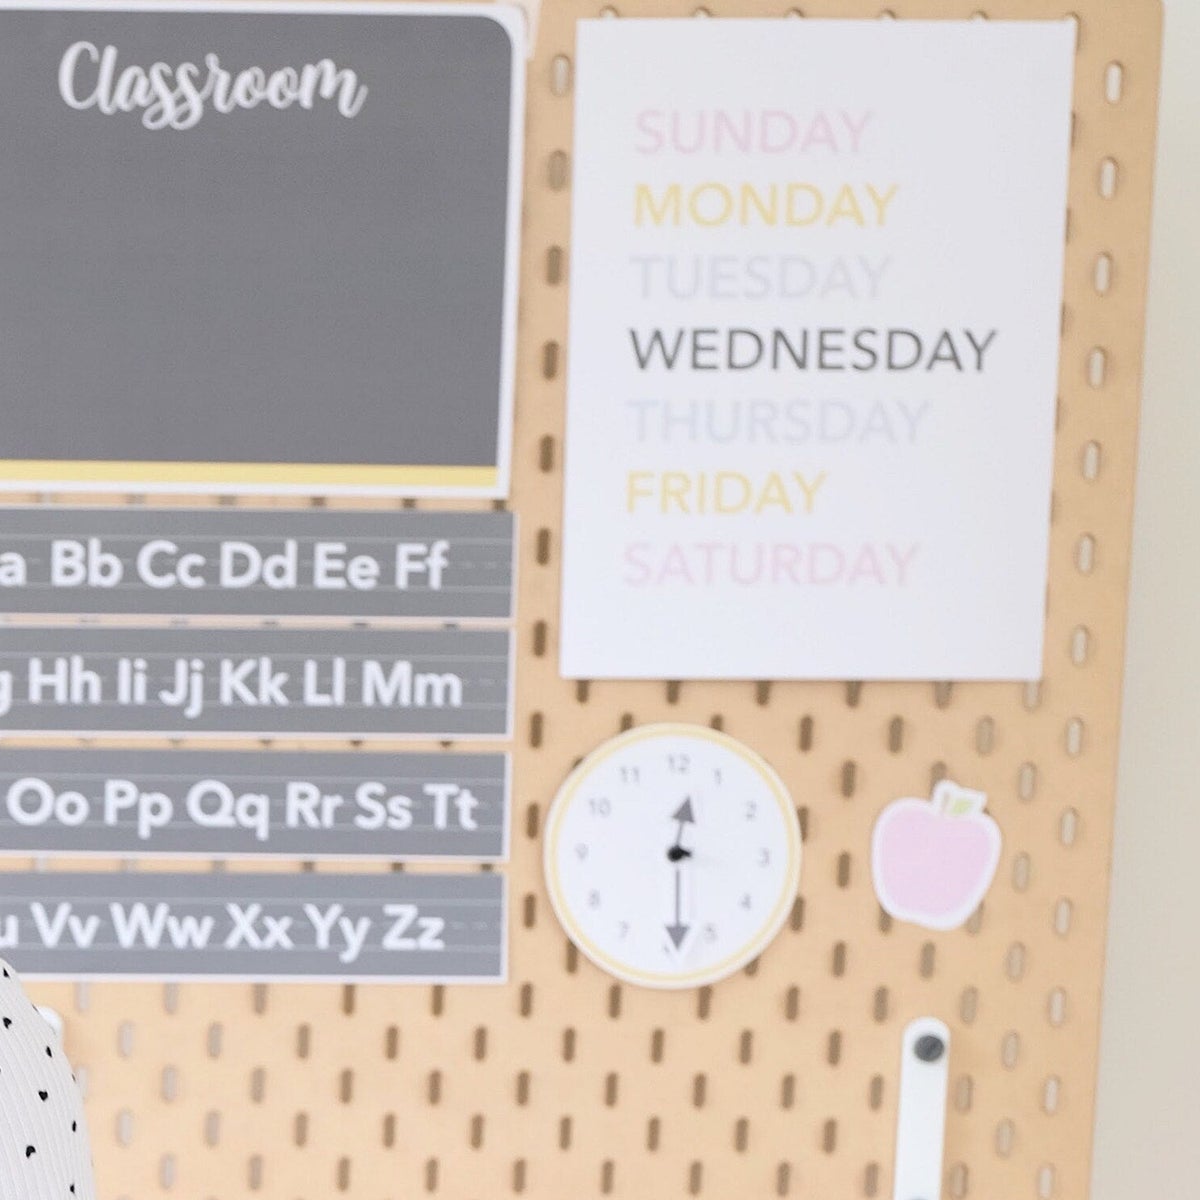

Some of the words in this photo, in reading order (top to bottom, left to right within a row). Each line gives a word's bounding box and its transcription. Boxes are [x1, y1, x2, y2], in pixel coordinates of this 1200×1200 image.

[57, 40, 369, 131] Classroom
[634, 108, 876, 157] SUNDAY
[632, 181, 899, 228] MONDAY
[628, 253, 895, 301] TUESDAY
[628, 327, 997, 373] WEDNESDAY
[623, 398, 932, 445] THURSDAY
[625, 469, 829, 516] FRIDAY
[50, 536, 124, 588] Bb
[136, 538, 206, 590] Cc
[219, 538, 298, 590] Dd
[313, 541, 381, 591] Ee
[395, 539, 450, 591] Ff
[622, 541, 922, 588] SATURDAY
[28, 654, 102, 705] Hh
[116, 657, 148, 704] Ii
[158, 657, 205, 719] Jj
[217, 656, 290, 706] Kk
[303, 656, 347, 707] Ll
[360, 659, 464, 707] Mm
[618, 765, 641, 784] 11
[666, 753, 692, 775] 12
[712, 767, 724, 788] 1
[5, 776, 90, 827] Oo
[103, 778, 174, 840] Pp
[185, 778, 271, 842] Qq
[285, 780, 345, 829] Rr
[354, 781, 413, 831] Ss
[423, 782, 480, 831] Tt
[587, 796, 613, 818] 10
[744, 800, 758, 822] 2
[758, 846, 772, 868] 3
[739, 893, 753, 911] 4
[29, 901, 101, 949] Vv
[109, 901, 215, 950] Ww
[224, 902, 295, 951] Xx
[303, 902, 372, 964] Yy
[381, 903, 446, 951] Zz
